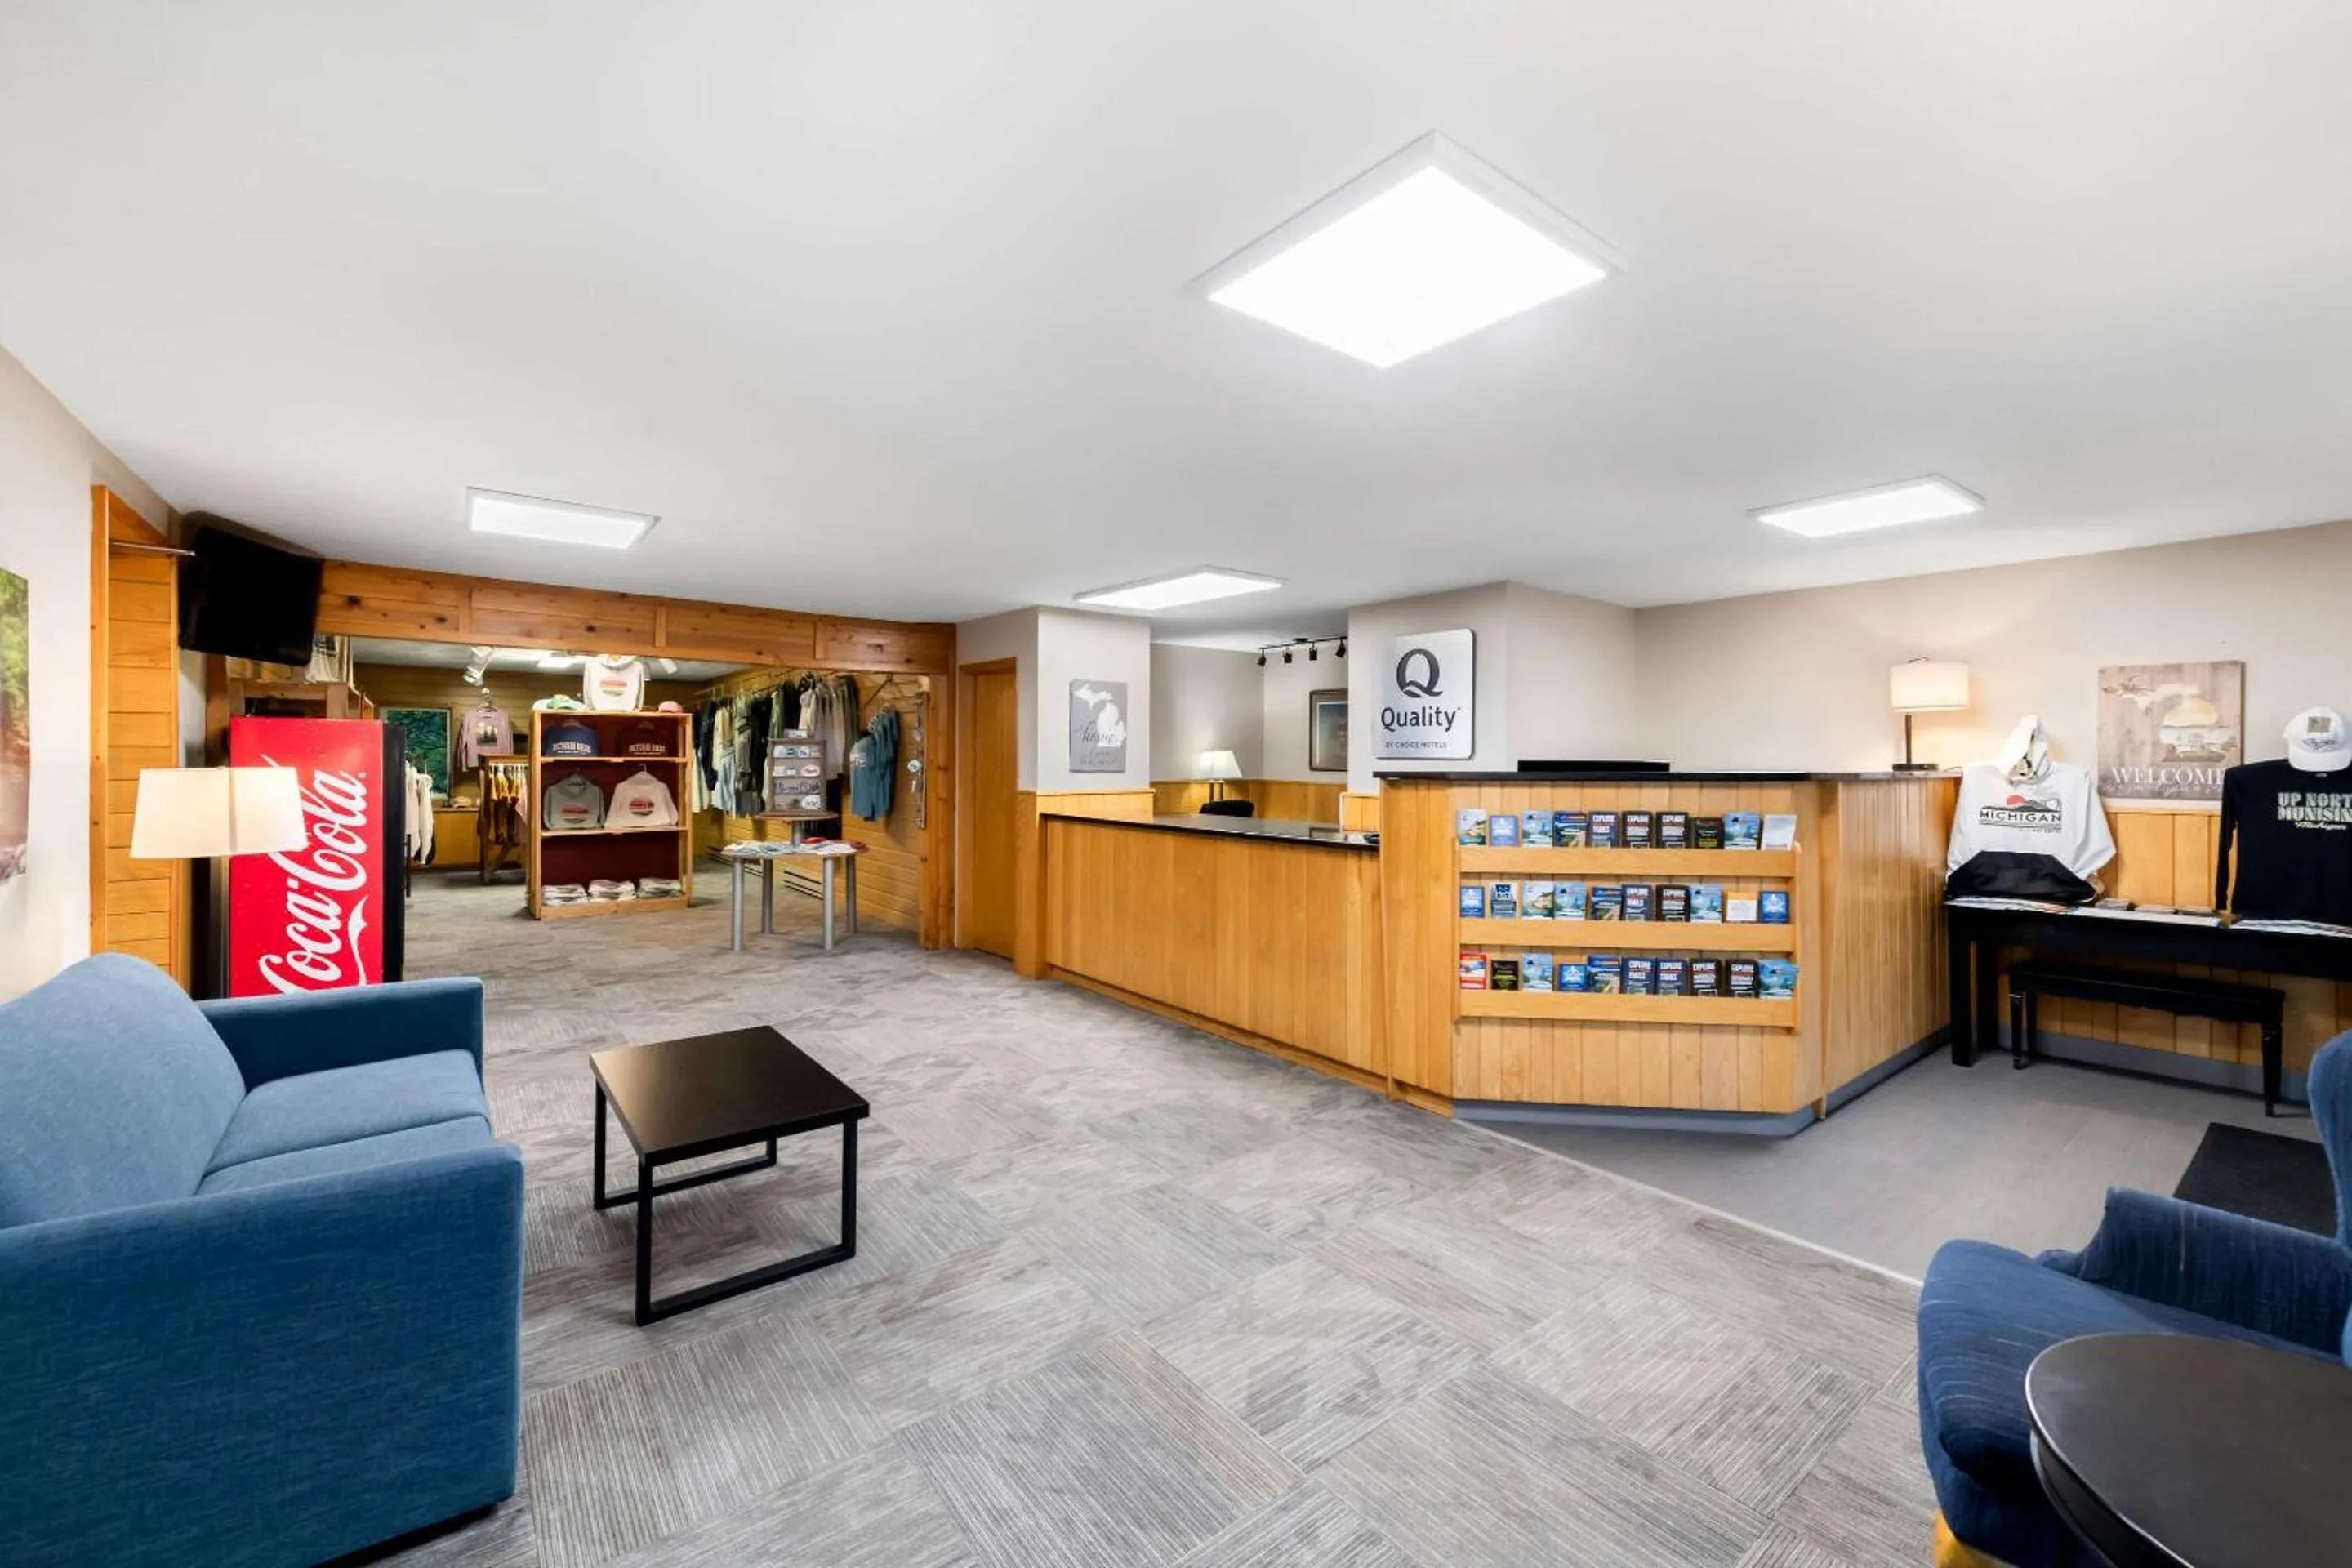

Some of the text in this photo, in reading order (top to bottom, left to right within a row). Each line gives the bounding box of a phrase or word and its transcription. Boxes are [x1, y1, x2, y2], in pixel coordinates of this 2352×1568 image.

[1381, 706, 1456, 732] Quality
[1395, 741, 1419, 749] CHOICE
[1420, 741, 1448, 749] HOTELS
[2277, 792, 2302, 807] UP
[1980, 809, 2062, 822] MICHIGAN
